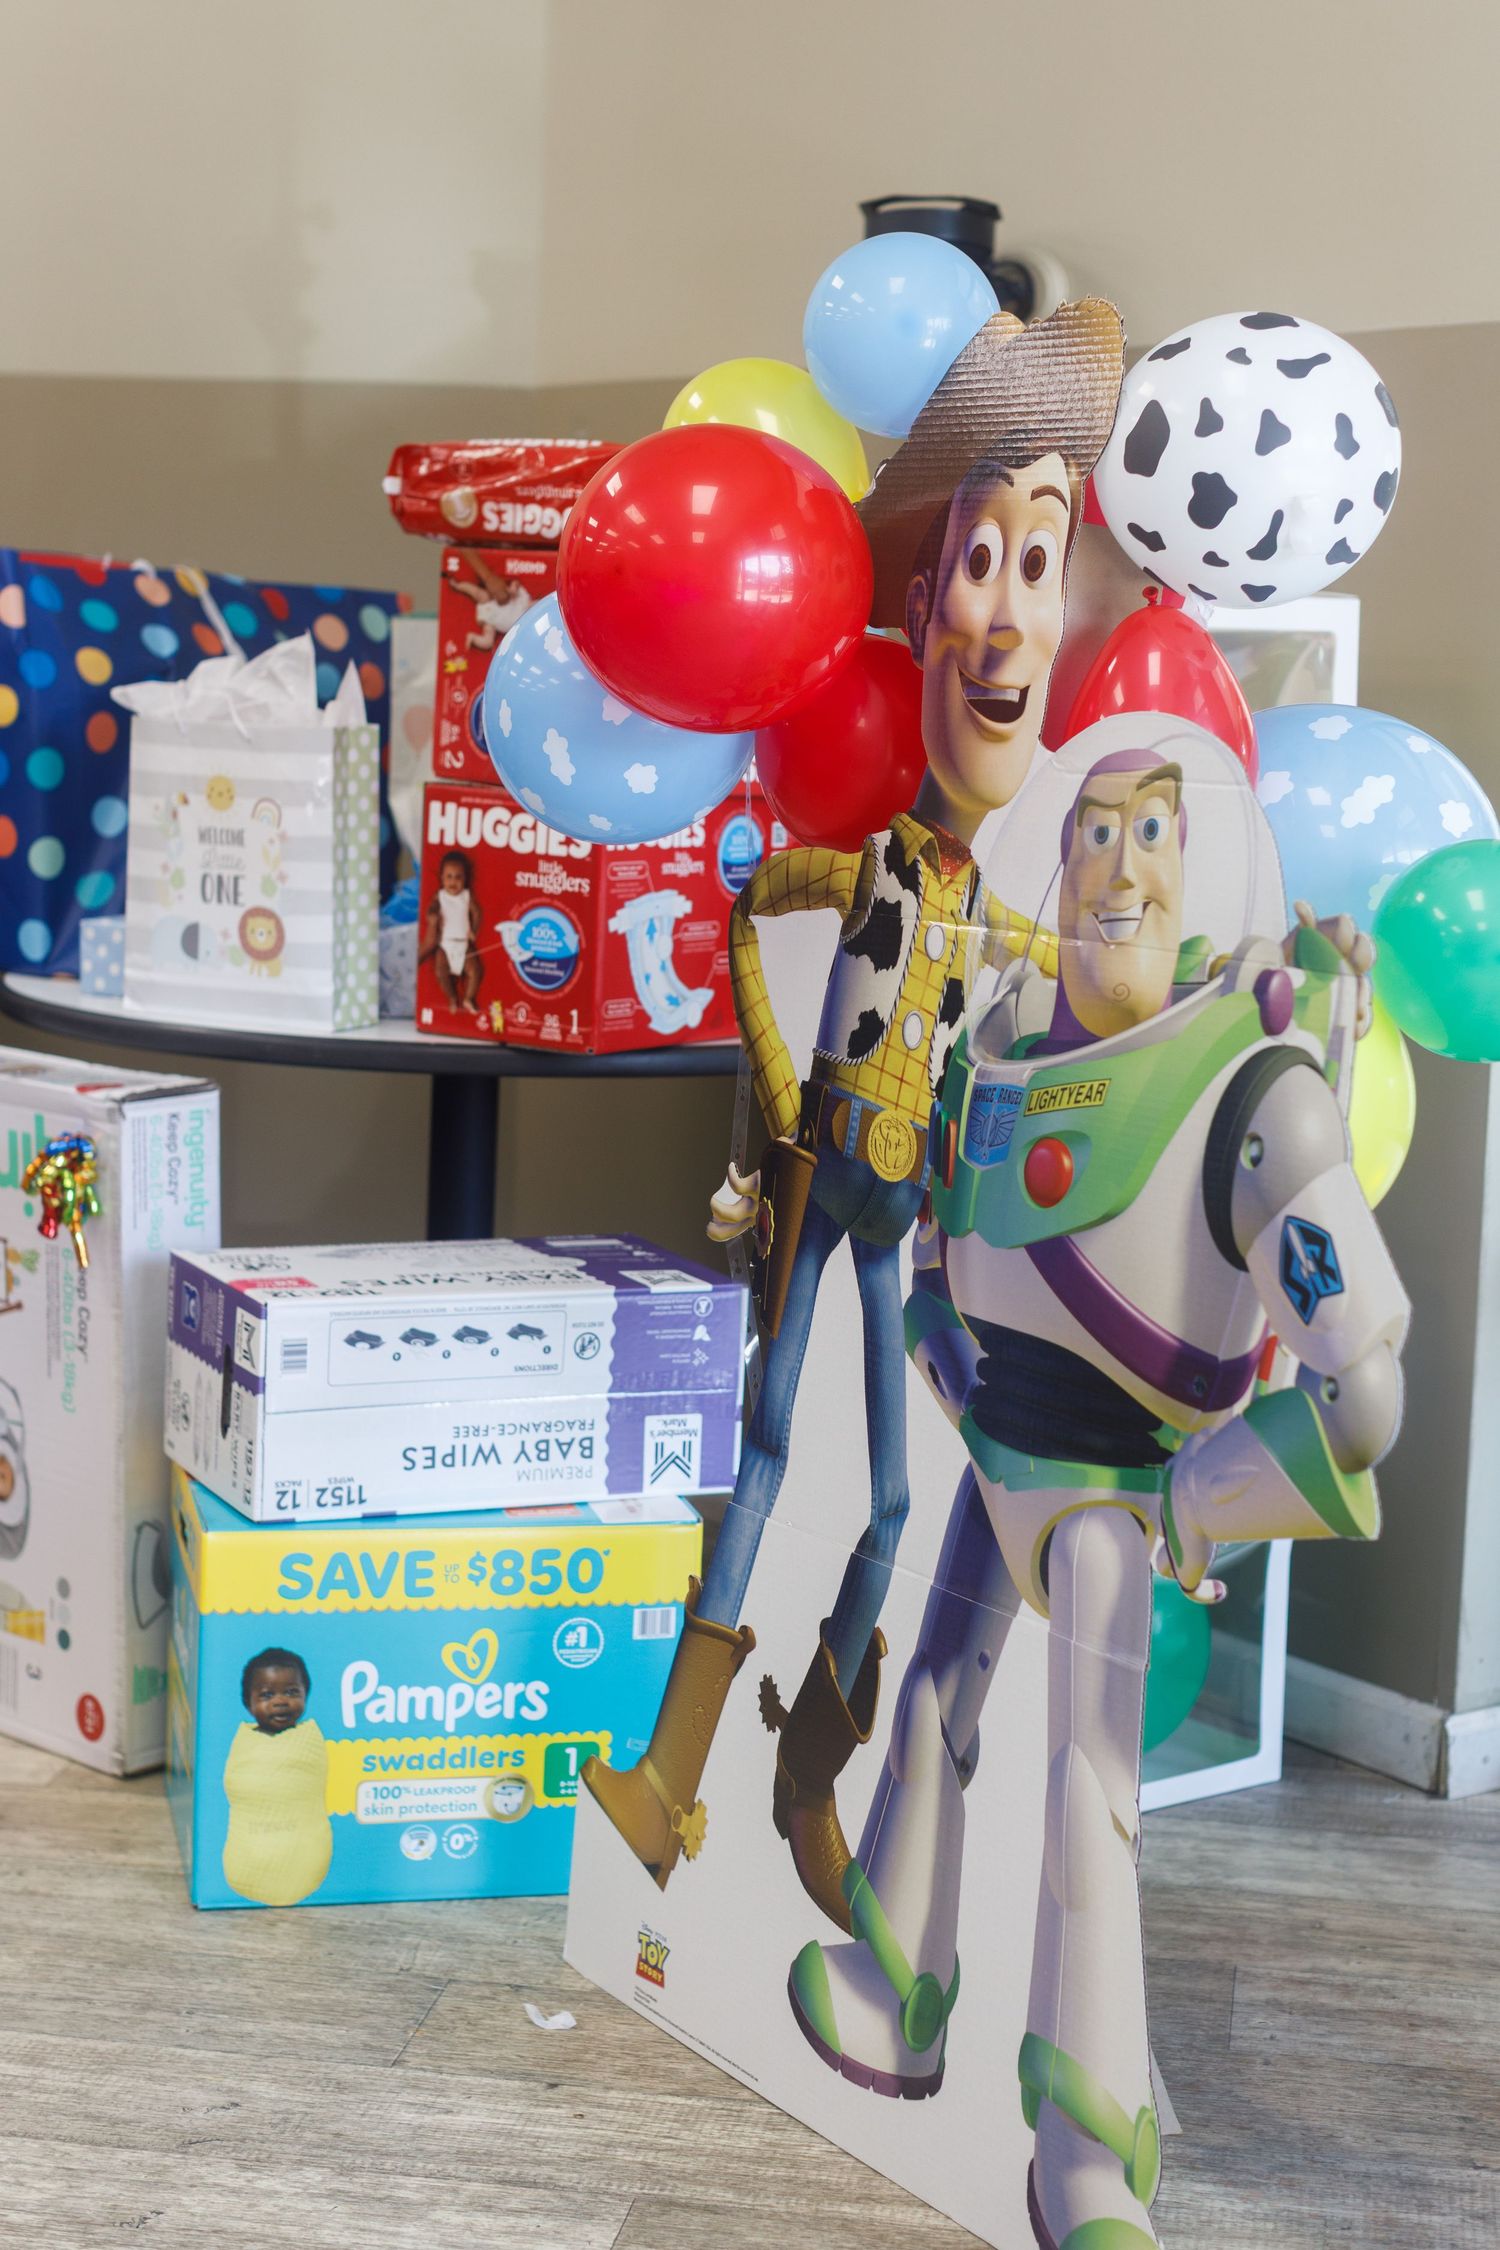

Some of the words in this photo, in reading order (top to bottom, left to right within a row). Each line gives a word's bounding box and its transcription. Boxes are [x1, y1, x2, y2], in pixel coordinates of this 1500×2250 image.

[482, 500, 574, 540] GGIES
[444, 750, 464, 769] 2
[537, 859, 564, 874] little
[201, 873, 246, 907] ONE
[514, 870, 591, 895] snugglers
[570, 1008, 579, 1036] 1
[974, 1086, 997, 1102] SPACE
[1026, 1082, 1107, 1112] LIGHTYEAR
[183, 1108, 209, 1230] ingenuity
[513, 1363, 559, 1373] DIRECTIONS
[452, 1417, 595, 1438] FRAGRANCE-FREE
[649, 1426, 699, 1438] Member's
[402, 1443, 502, 1472] WIPES
[514, 1437, 595, 1465] BABY
[275, 1480, 302, 1489] PACKS
[327, 1476, 355, 1486] WIPES
[516, 1465, 594, 1483] PREMIUM
[275, 1489, 301, 1510] 12
[315, 1485, 367, 1508] 1152
[277, 1550, 436, 1601] SAVE
[444, 1563, 460, 1574] UP
[444, 1573, 460, 1584] TO
[467, 1547, 605, 1596] $850
[564, 1626, 588, 1648] #1
[340, 1660, 550, 1732] Pampers
[362, 1746, 526, 1773] swaddlers
[564, 1746, 577, 1777] 1
[371, 1785, 412, 1800] 100%
[413, 1785, 478, 1798] LEAKPROOF
[363, 1802, 394, 1816] skin
[398, 1800, 478, 1818] protection
[638, 1930, 670, 1972] TOY
[639, 1961, 663, 1983] STORY
